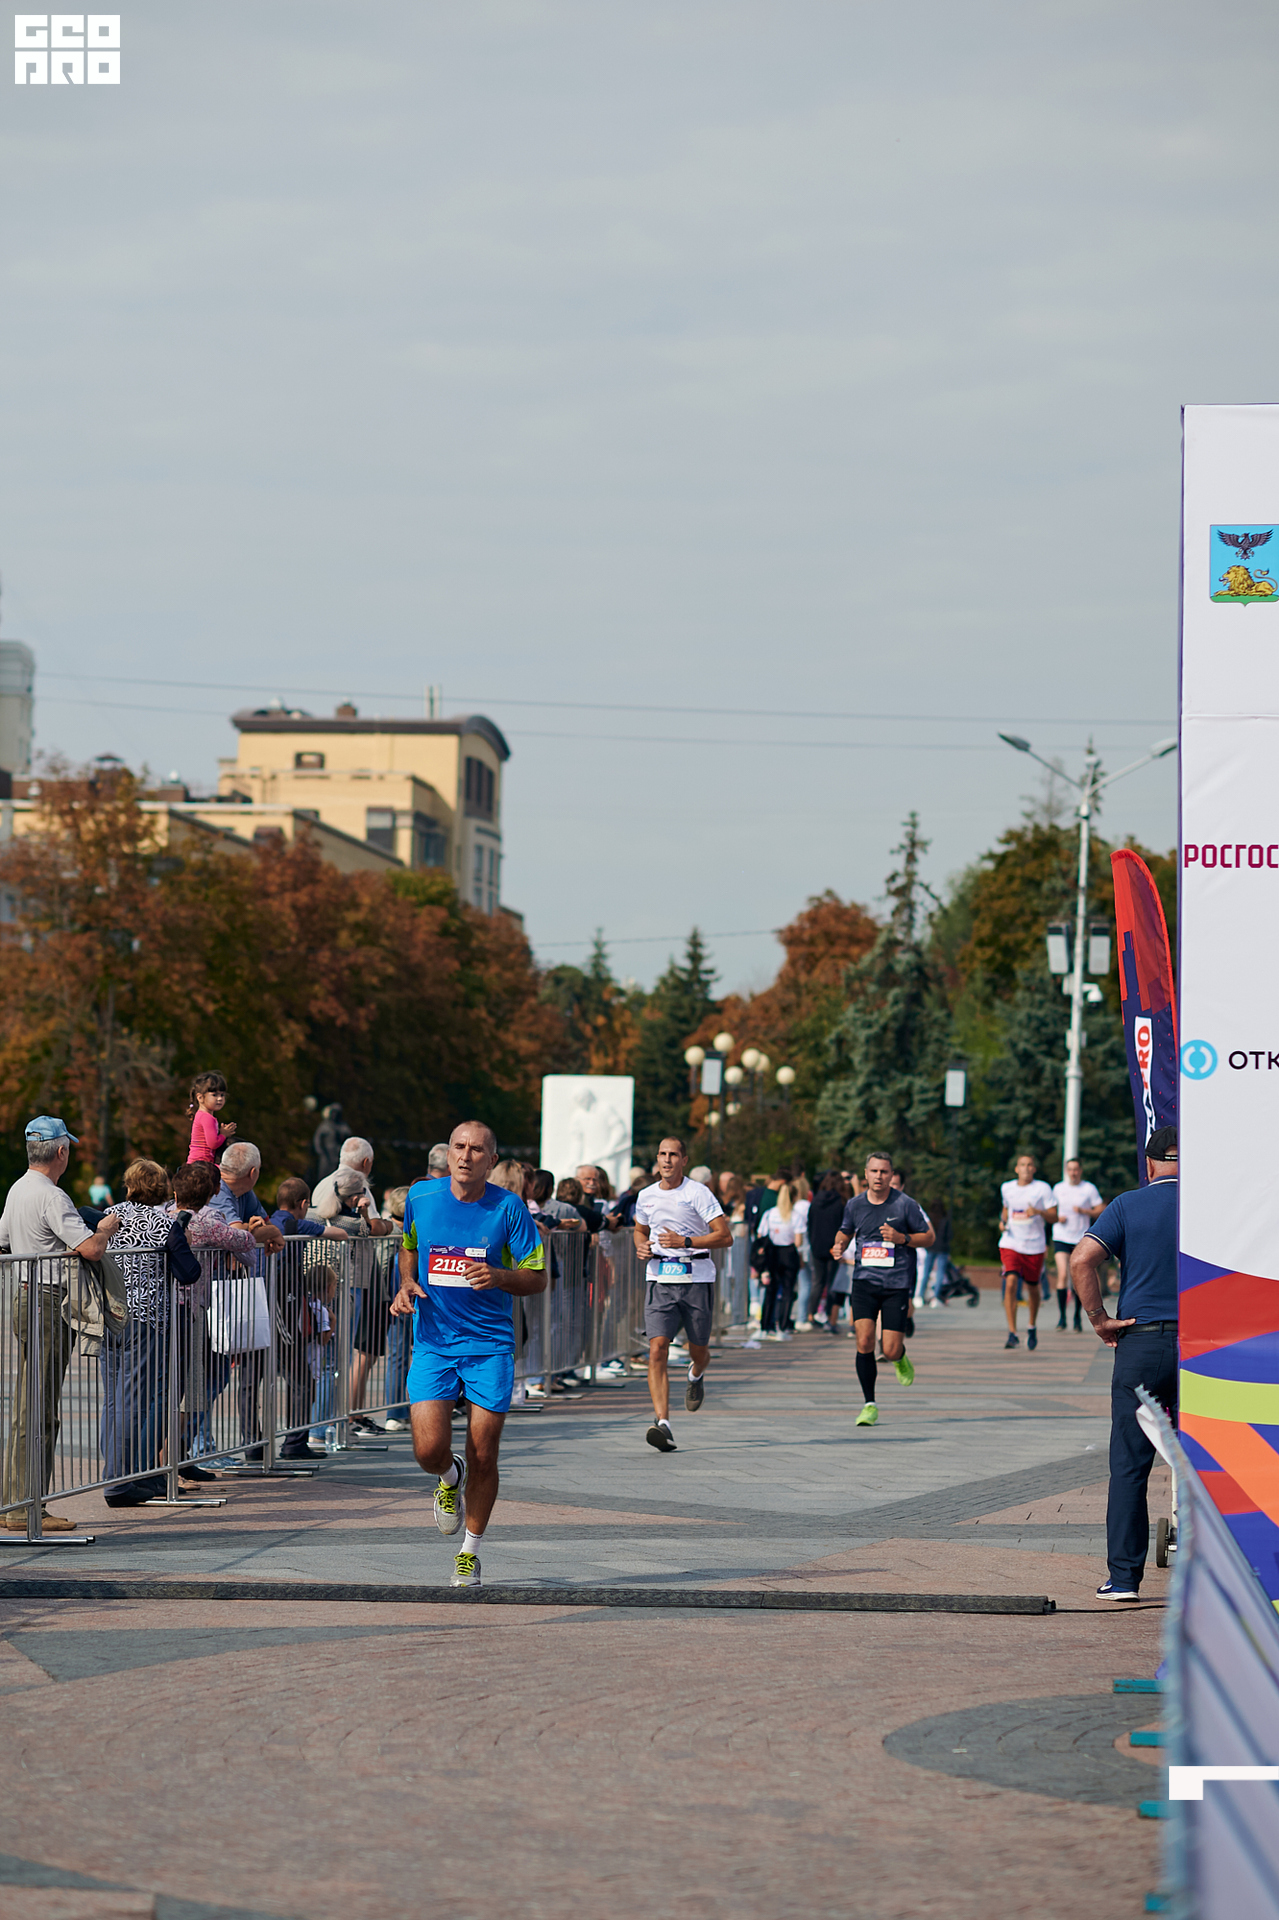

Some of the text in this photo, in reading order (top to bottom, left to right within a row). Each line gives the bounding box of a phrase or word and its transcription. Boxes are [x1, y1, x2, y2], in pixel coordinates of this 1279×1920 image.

[1184, 844, 1279, 868] РОСГОС
[1229, 1050, 1279, 1070] ОТК
[864, 1249, 887, 1257] 2302
[432, 1258, 467, 1272] 2118
[662, 1265, 683, 1274] 1079
